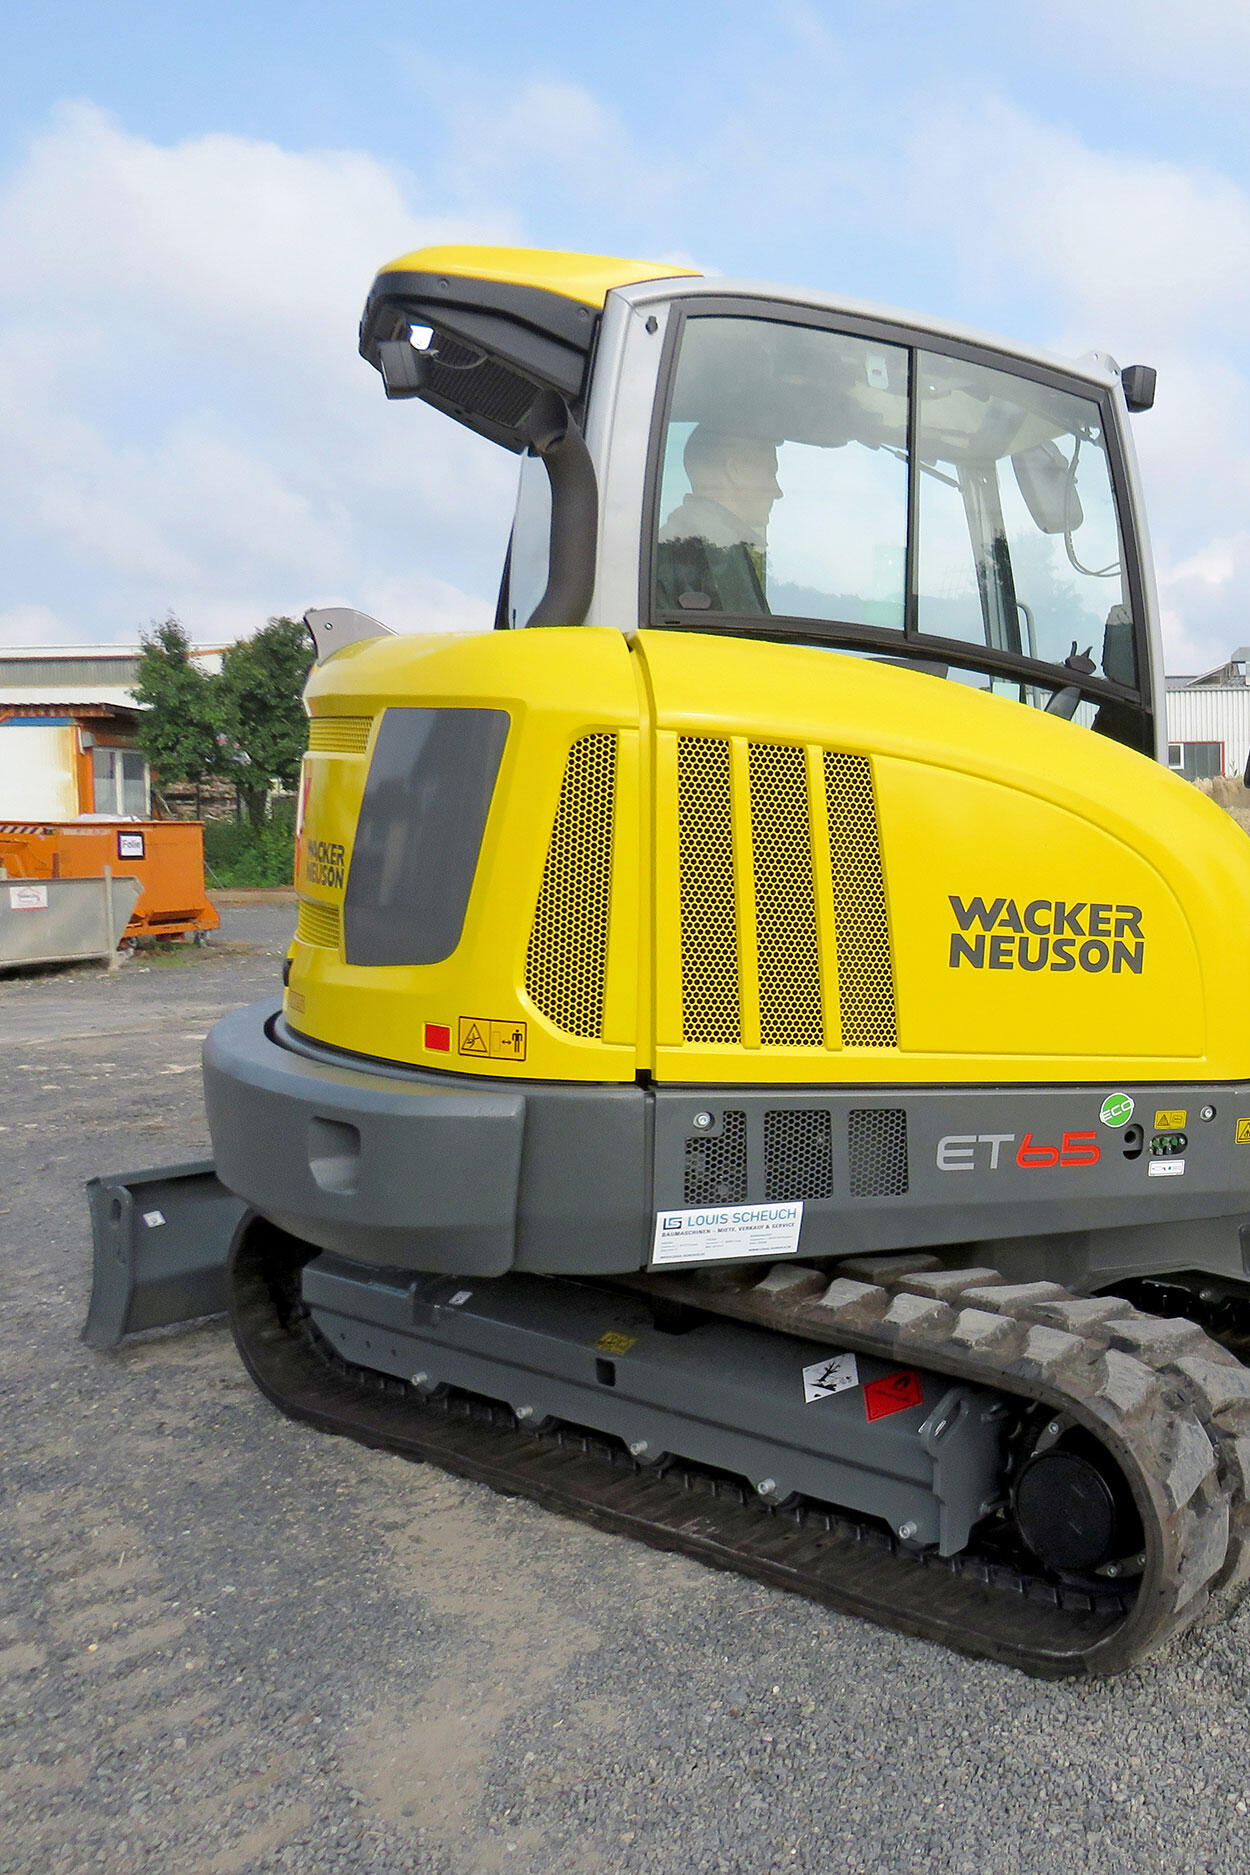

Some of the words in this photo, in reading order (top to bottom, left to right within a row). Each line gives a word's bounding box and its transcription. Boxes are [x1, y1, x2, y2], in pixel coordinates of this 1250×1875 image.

[947, 895, 1145, 938] WACKER
[948, 933, 1144, 974] NEUSON
[1100, 1098, 1135, 1121] ECO
[687, 1213, 728, 1227] LOUIS
[732, 1208, 797, 1223] SCHEUCH
